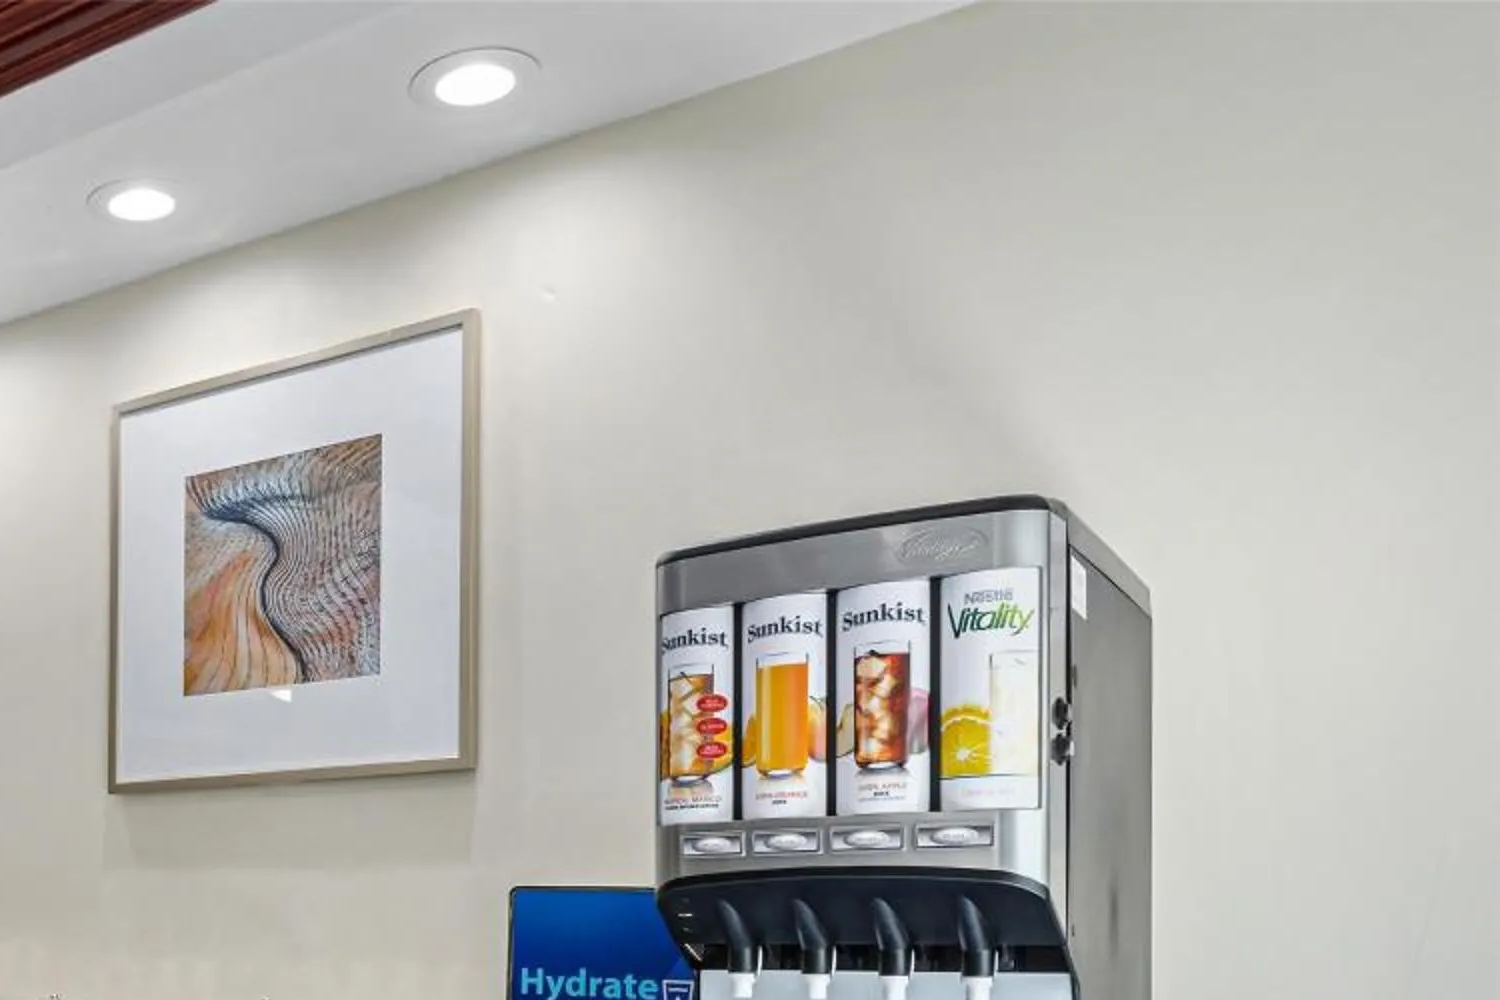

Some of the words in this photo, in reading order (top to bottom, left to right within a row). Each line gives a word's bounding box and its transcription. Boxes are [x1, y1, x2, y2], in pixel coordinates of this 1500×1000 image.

[747, 615, 823, 643] Sunkist
[842, 602, 926, 632] Sunkist
[947, 601, 1035, 639] Vitality
[661, 627, 729, 655] Sunkist
